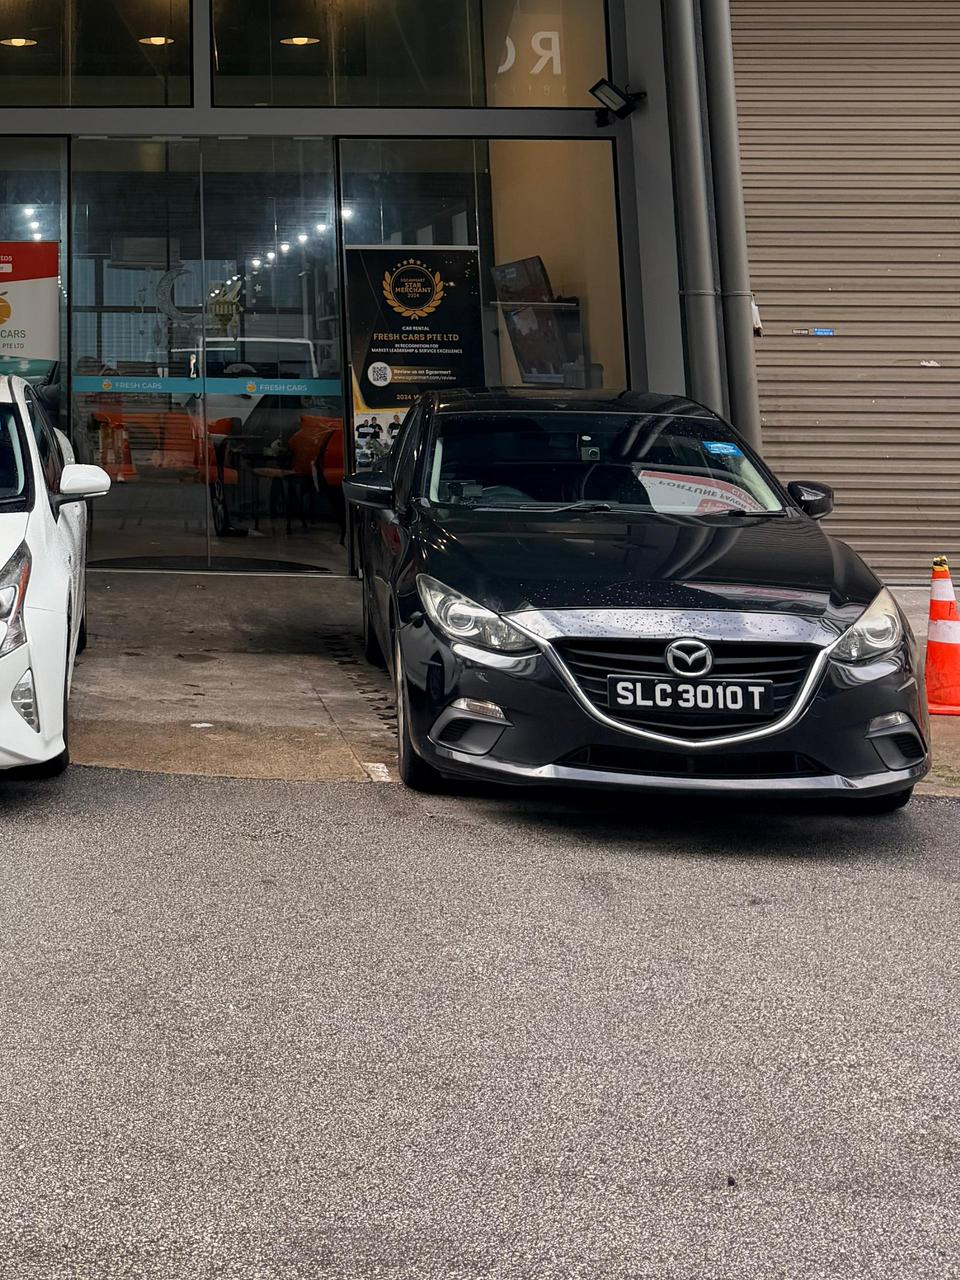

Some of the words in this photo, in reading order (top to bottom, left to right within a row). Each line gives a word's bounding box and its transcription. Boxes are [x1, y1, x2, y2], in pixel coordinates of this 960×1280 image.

[0, 329, 26, 339] CARS
[373, 333, 400, 341] FRESH
[401, 333, 425, 341] CARS
[426, 333, 442, 341] PTE
[443, 333, 460, 341] LTD
[286, 384, 308, 392] CARS
